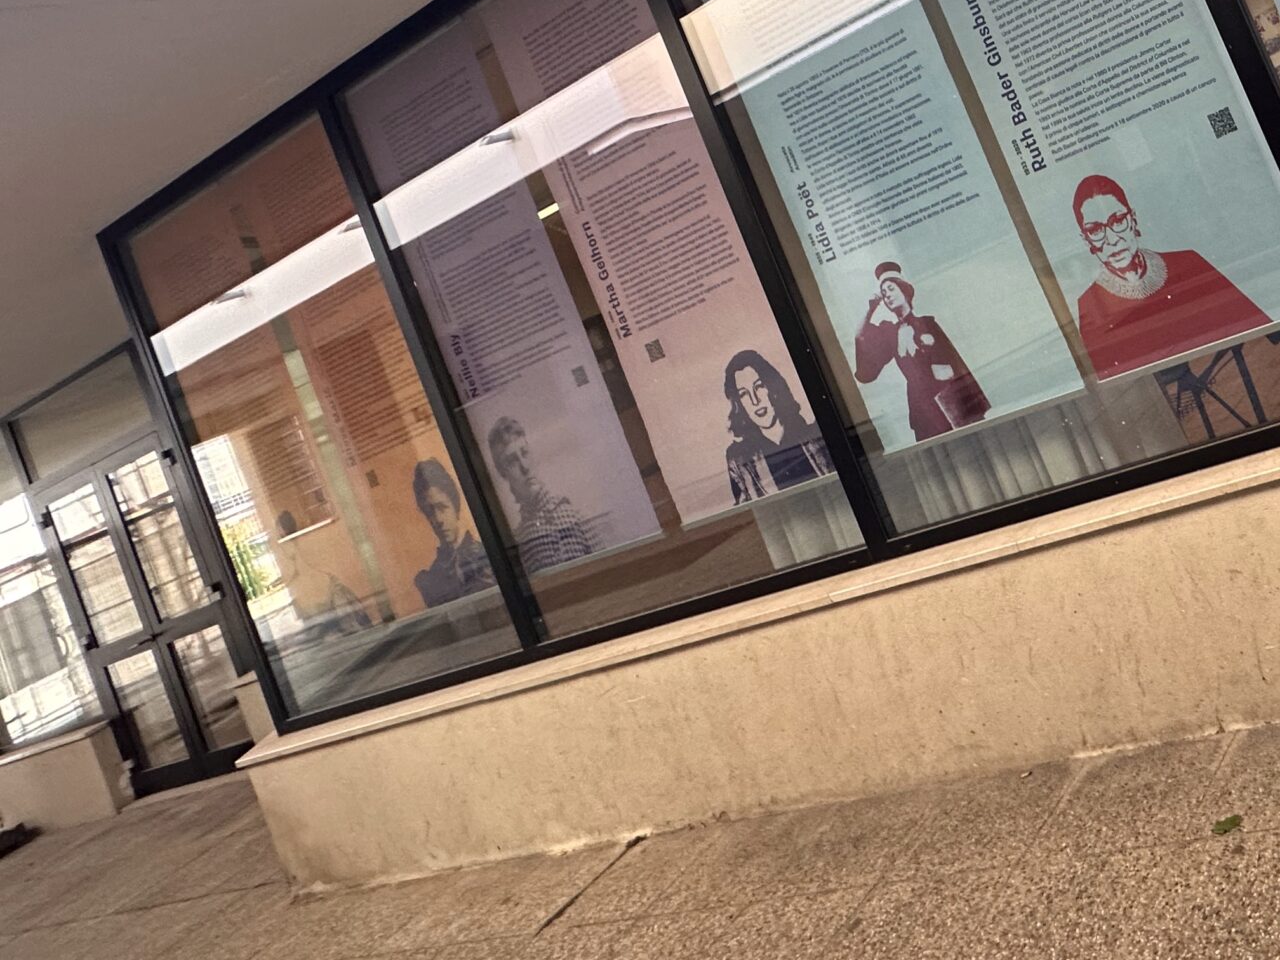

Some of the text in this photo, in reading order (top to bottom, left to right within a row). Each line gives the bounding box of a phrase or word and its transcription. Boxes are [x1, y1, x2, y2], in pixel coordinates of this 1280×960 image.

[996, 71, 1027, 126] Bader
[1019, 127, 1046, 172] Ruth
[796, 181, 818, 219] Poët
[814, 221, 836, 262] Lidia
[605, 282, 632, 338] Martha
[450, 334, 480, 398] Nellie Bly
